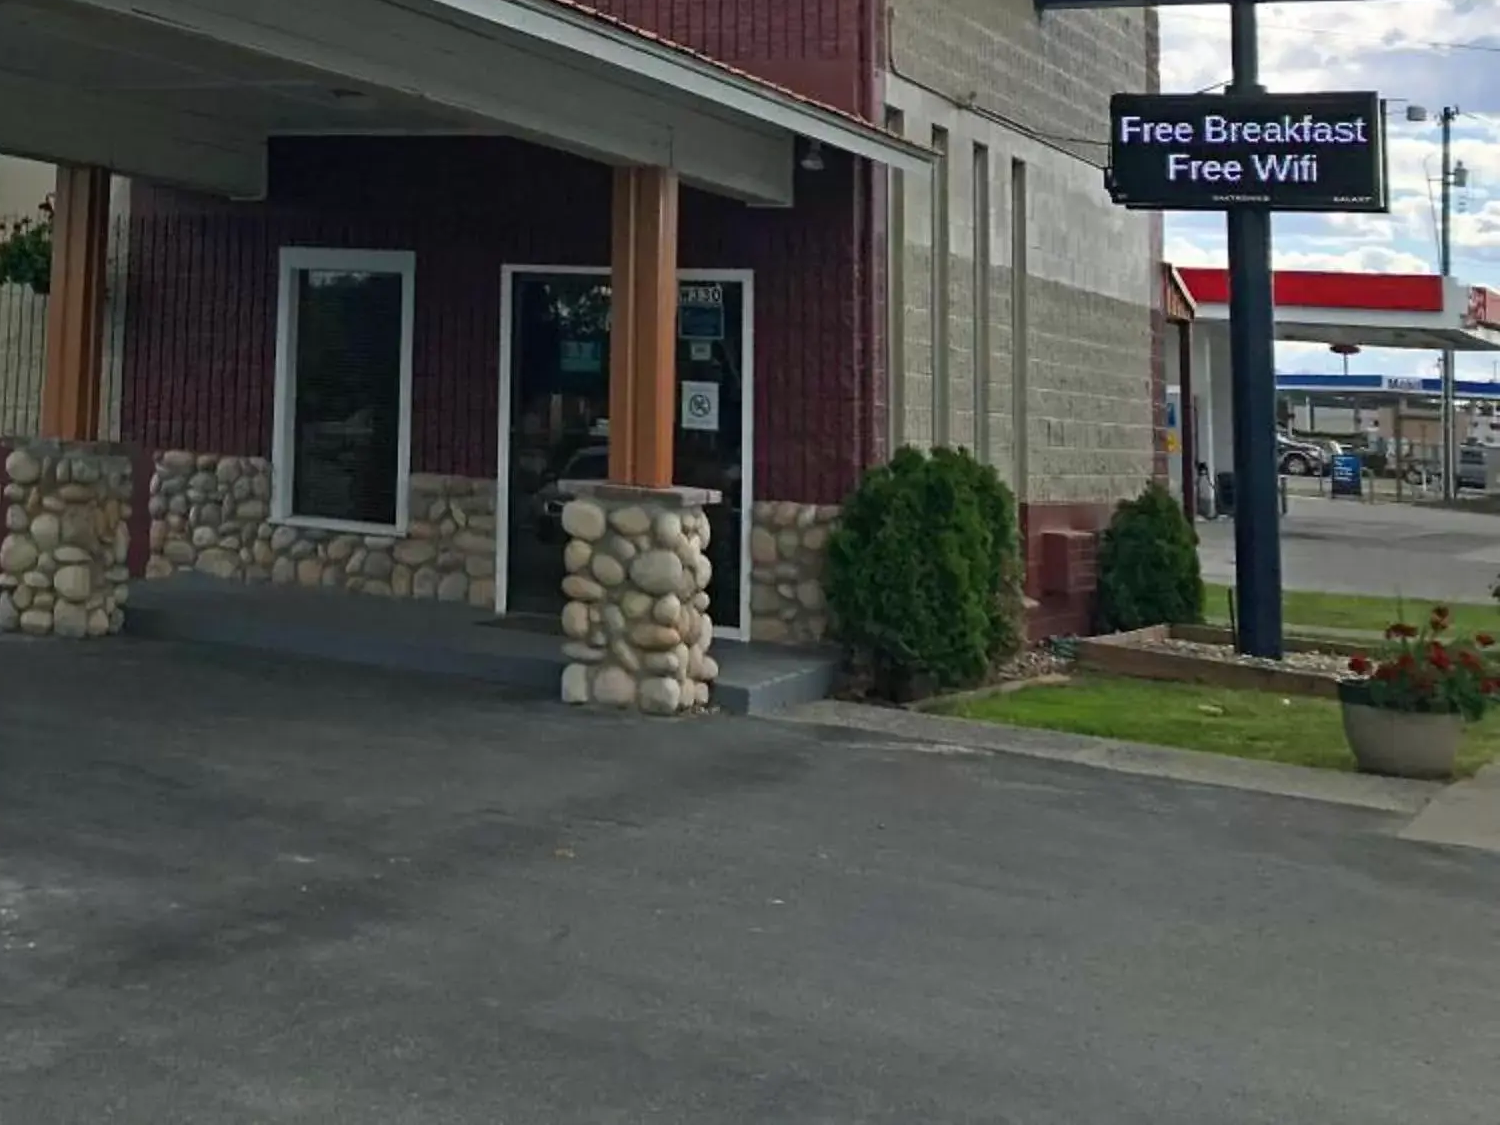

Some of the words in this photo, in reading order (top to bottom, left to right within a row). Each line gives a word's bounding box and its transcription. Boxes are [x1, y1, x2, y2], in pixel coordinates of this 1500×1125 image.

[1120, 116, 1193, 143] Free
[1204, 114, 1368, 143] Breakfast
[1168, 154, 1241, 181] Free
[1250, 154, 1317, 181] Wifi
